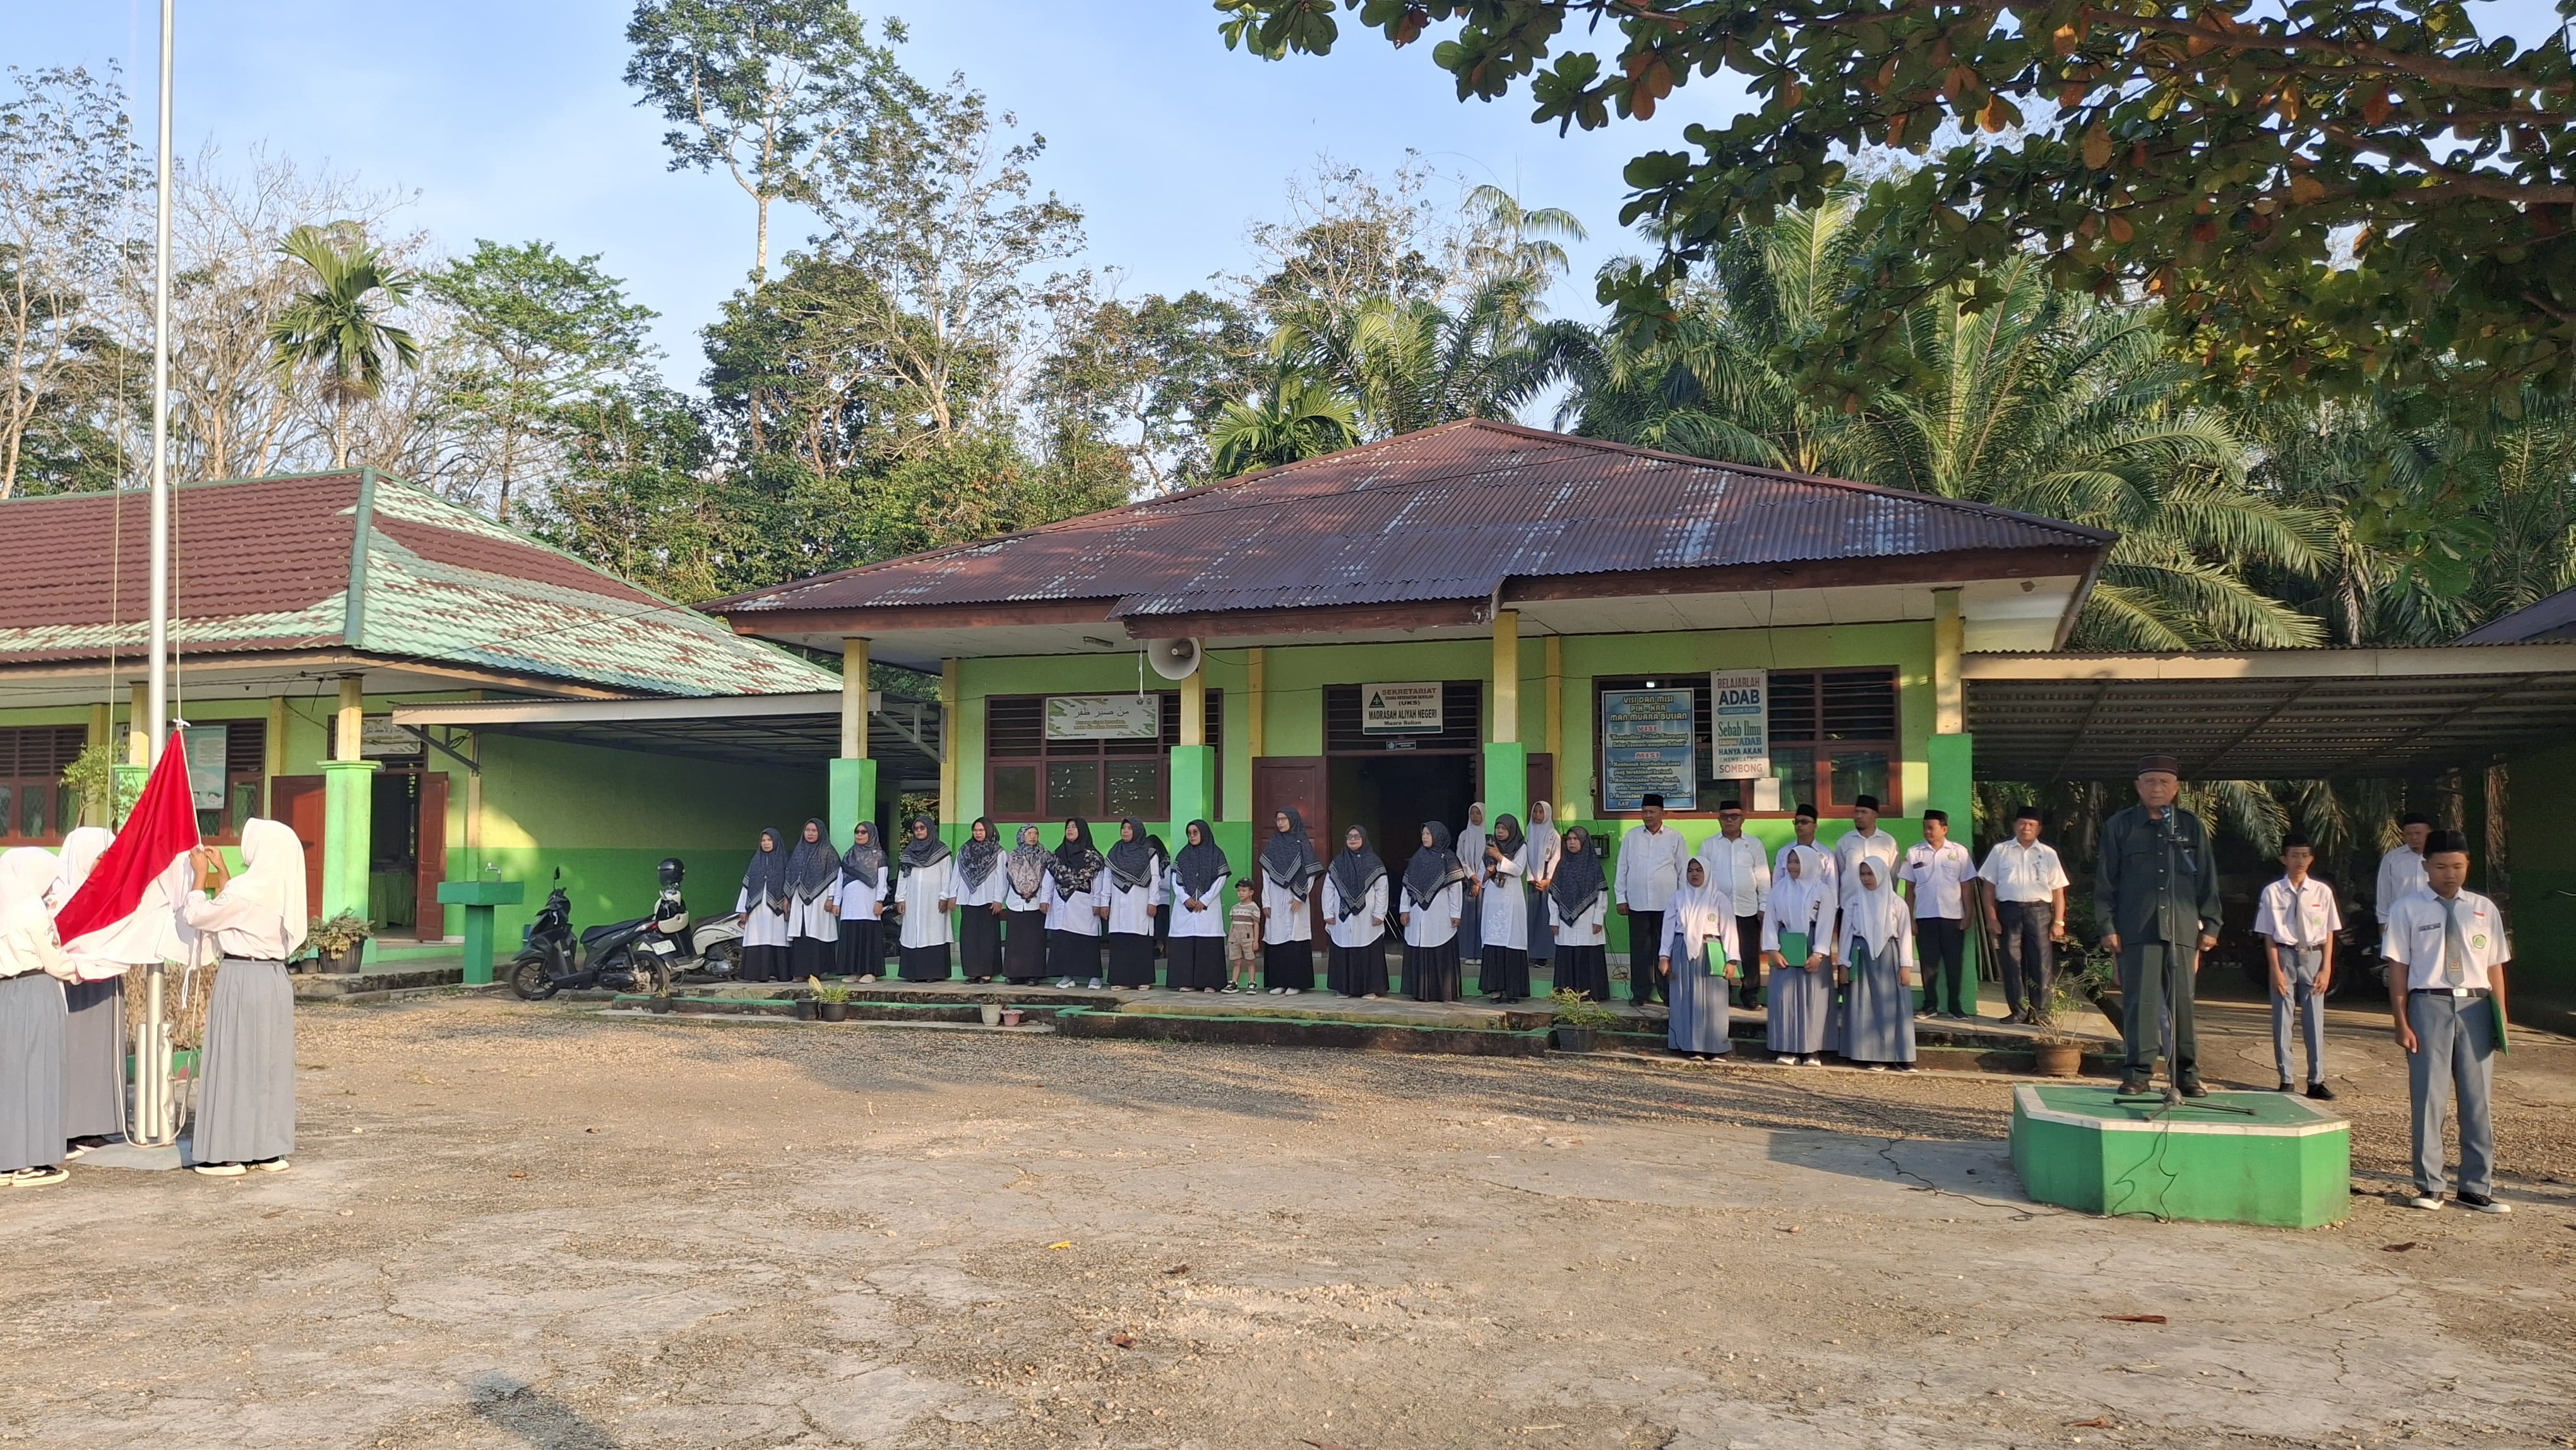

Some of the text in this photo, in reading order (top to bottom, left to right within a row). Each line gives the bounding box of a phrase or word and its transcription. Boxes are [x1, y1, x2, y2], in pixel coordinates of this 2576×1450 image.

[1717, 677, 1760, 688] BELAJARLAH
[1719, 690, 1760, 705] ADAB
[1369, 709, 1437, 720] MADRASAH ALIYAH NEGERI
[1660, 712, 1688, 721] BULIAN
[1718, 720, 1762, 737] Sebab Ilmu
[1739, 737, 1762, 746] ADAB
[1719, 764, 1763, 773] SOMBONG
